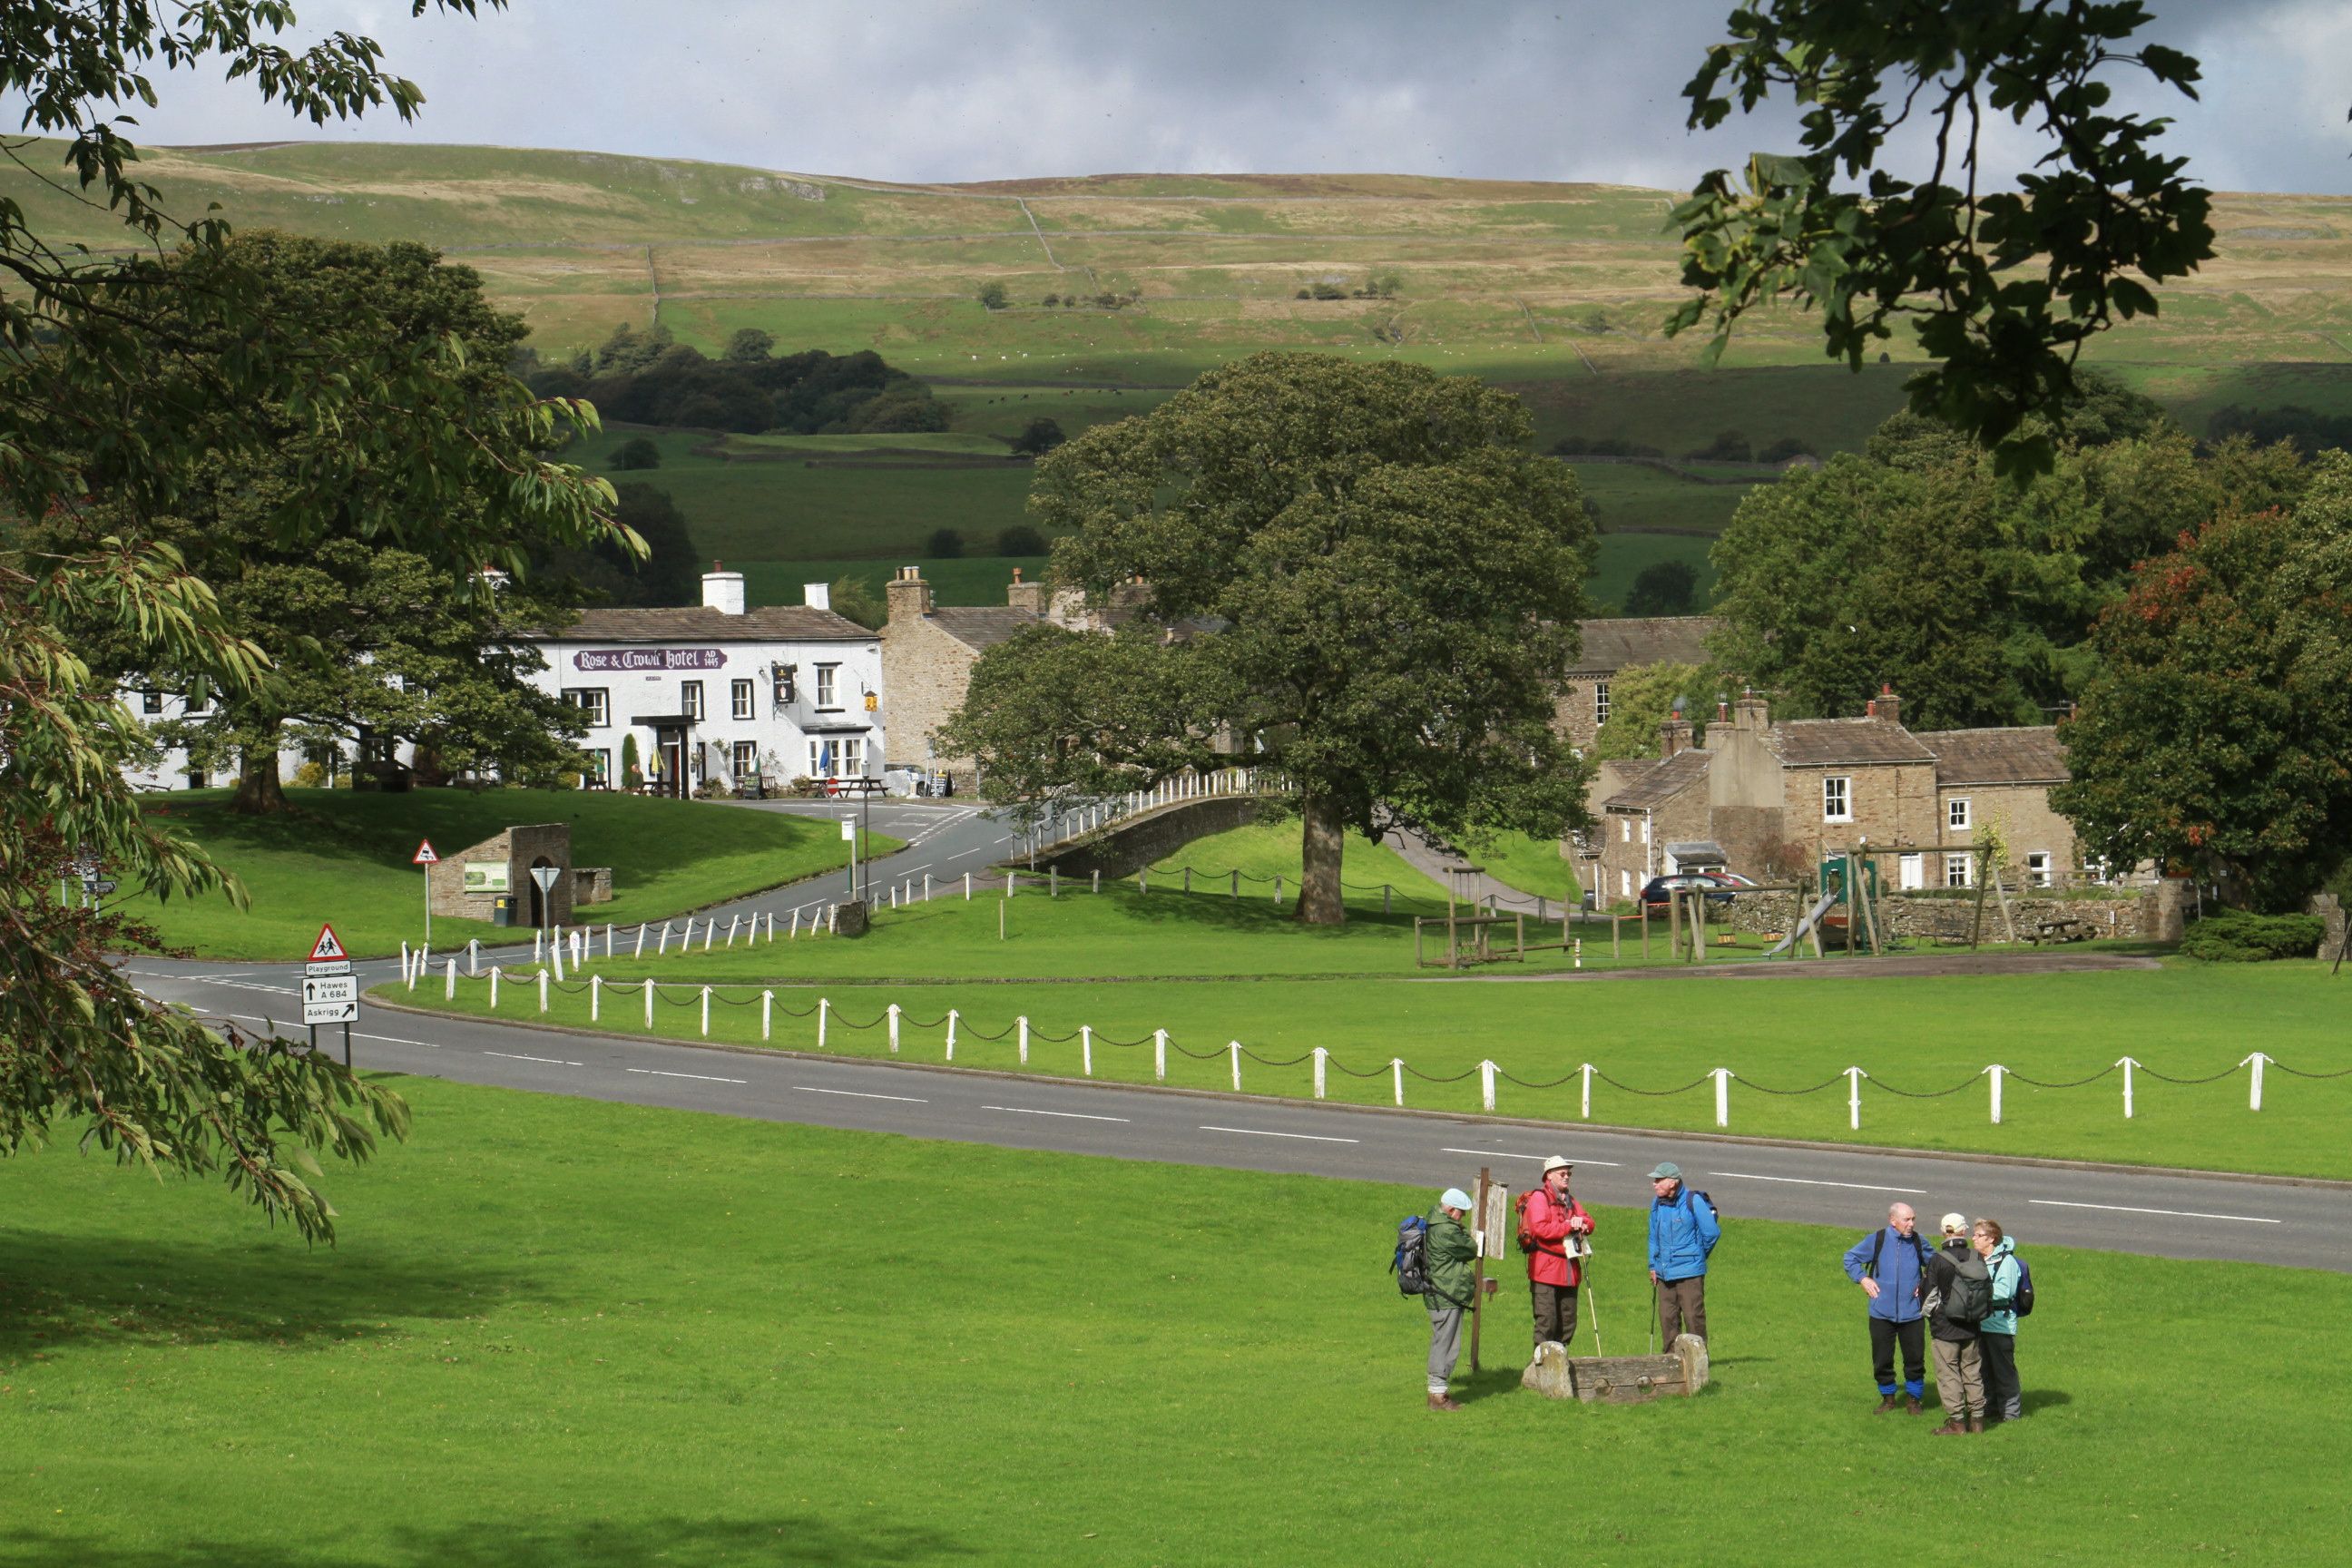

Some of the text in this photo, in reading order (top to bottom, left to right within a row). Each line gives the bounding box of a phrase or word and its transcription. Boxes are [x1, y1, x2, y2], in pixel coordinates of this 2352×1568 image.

[581, 651, 699, 669] Rose & Crown Hotel
[309, 964, 348, 972] Playground
[329, 990, 347, 998] 684
[308, 1008, 338, 1016] Askrigg
